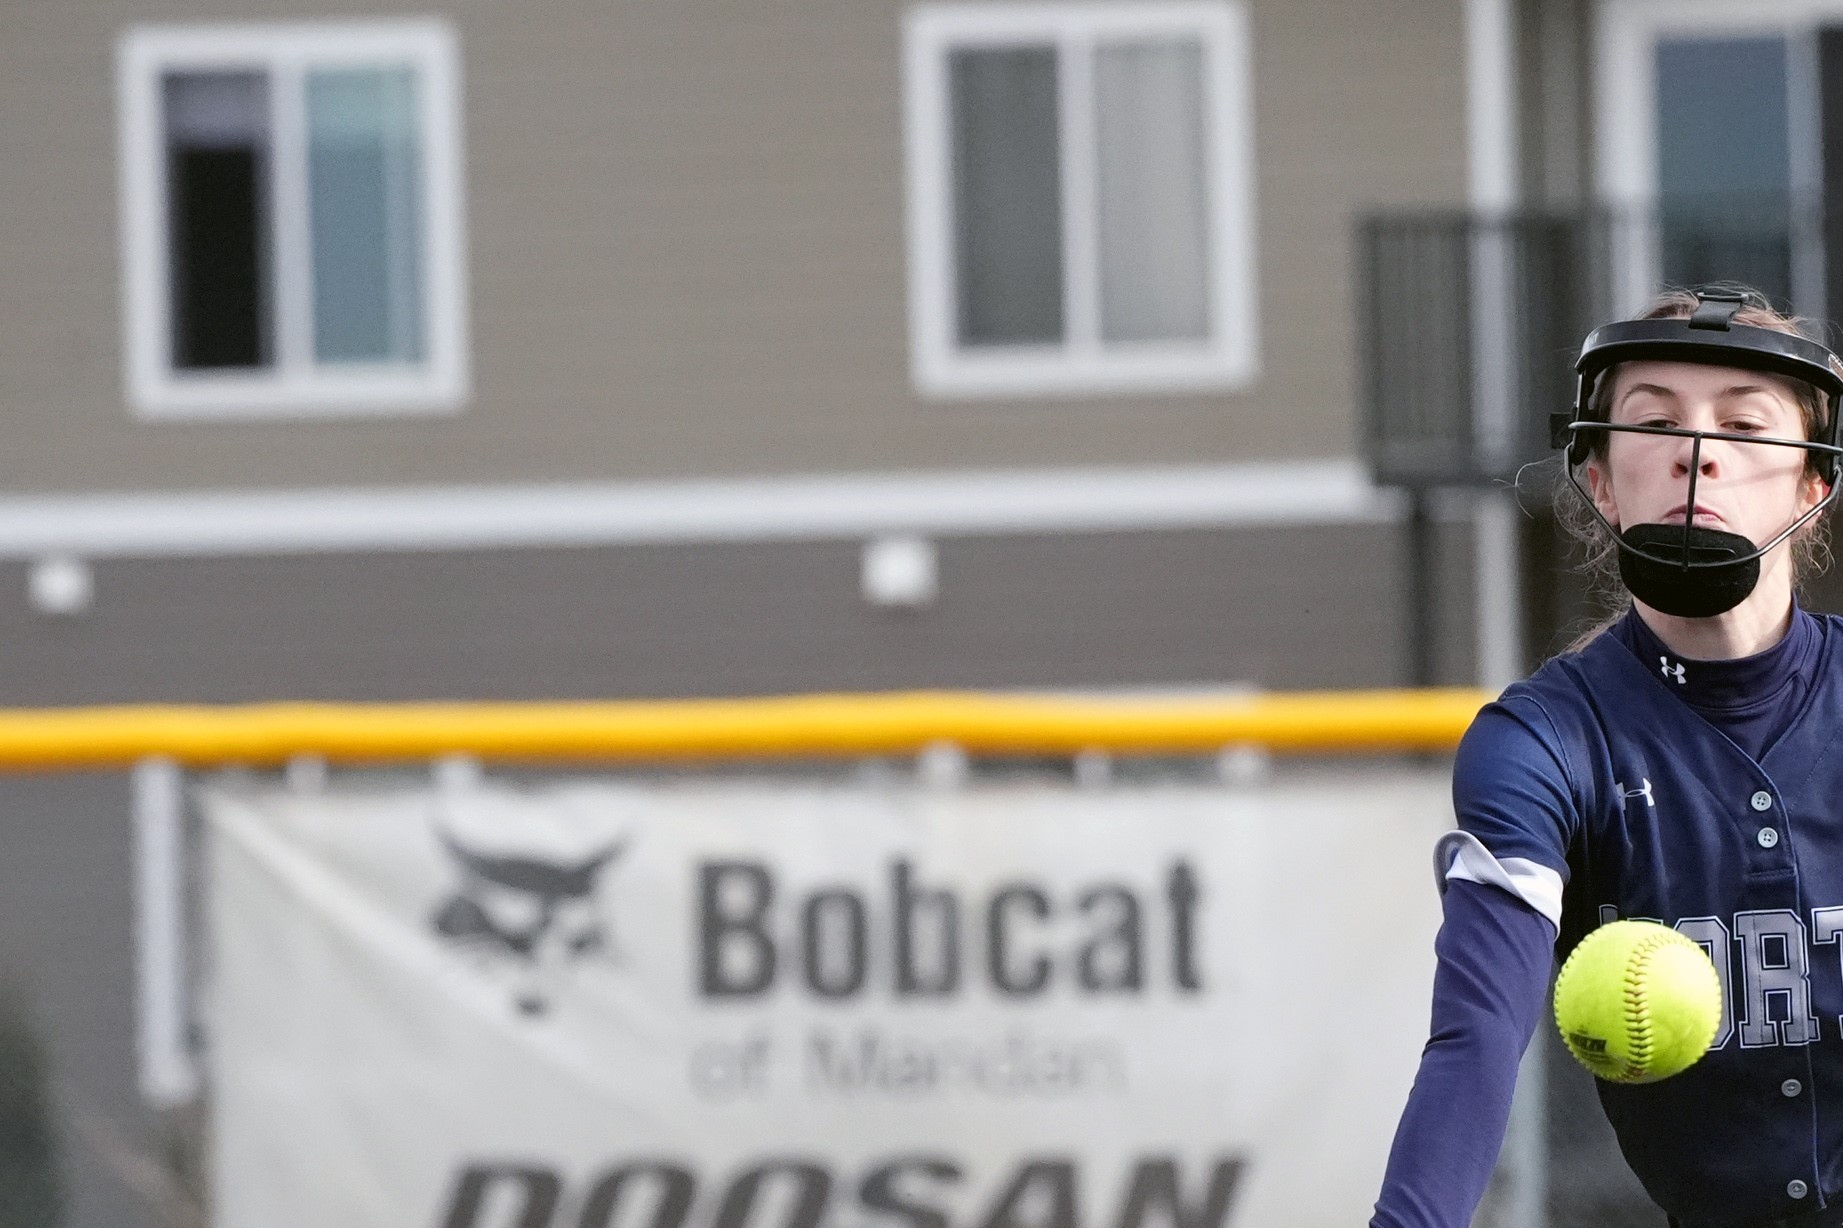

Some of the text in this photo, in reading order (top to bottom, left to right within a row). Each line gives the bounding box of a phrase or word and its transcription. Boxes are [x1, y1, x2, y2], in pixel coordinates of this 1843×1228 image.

[696, 857, 1206, 998] Bobcat
[690, 1022, 1133, 1098] of Mandan
